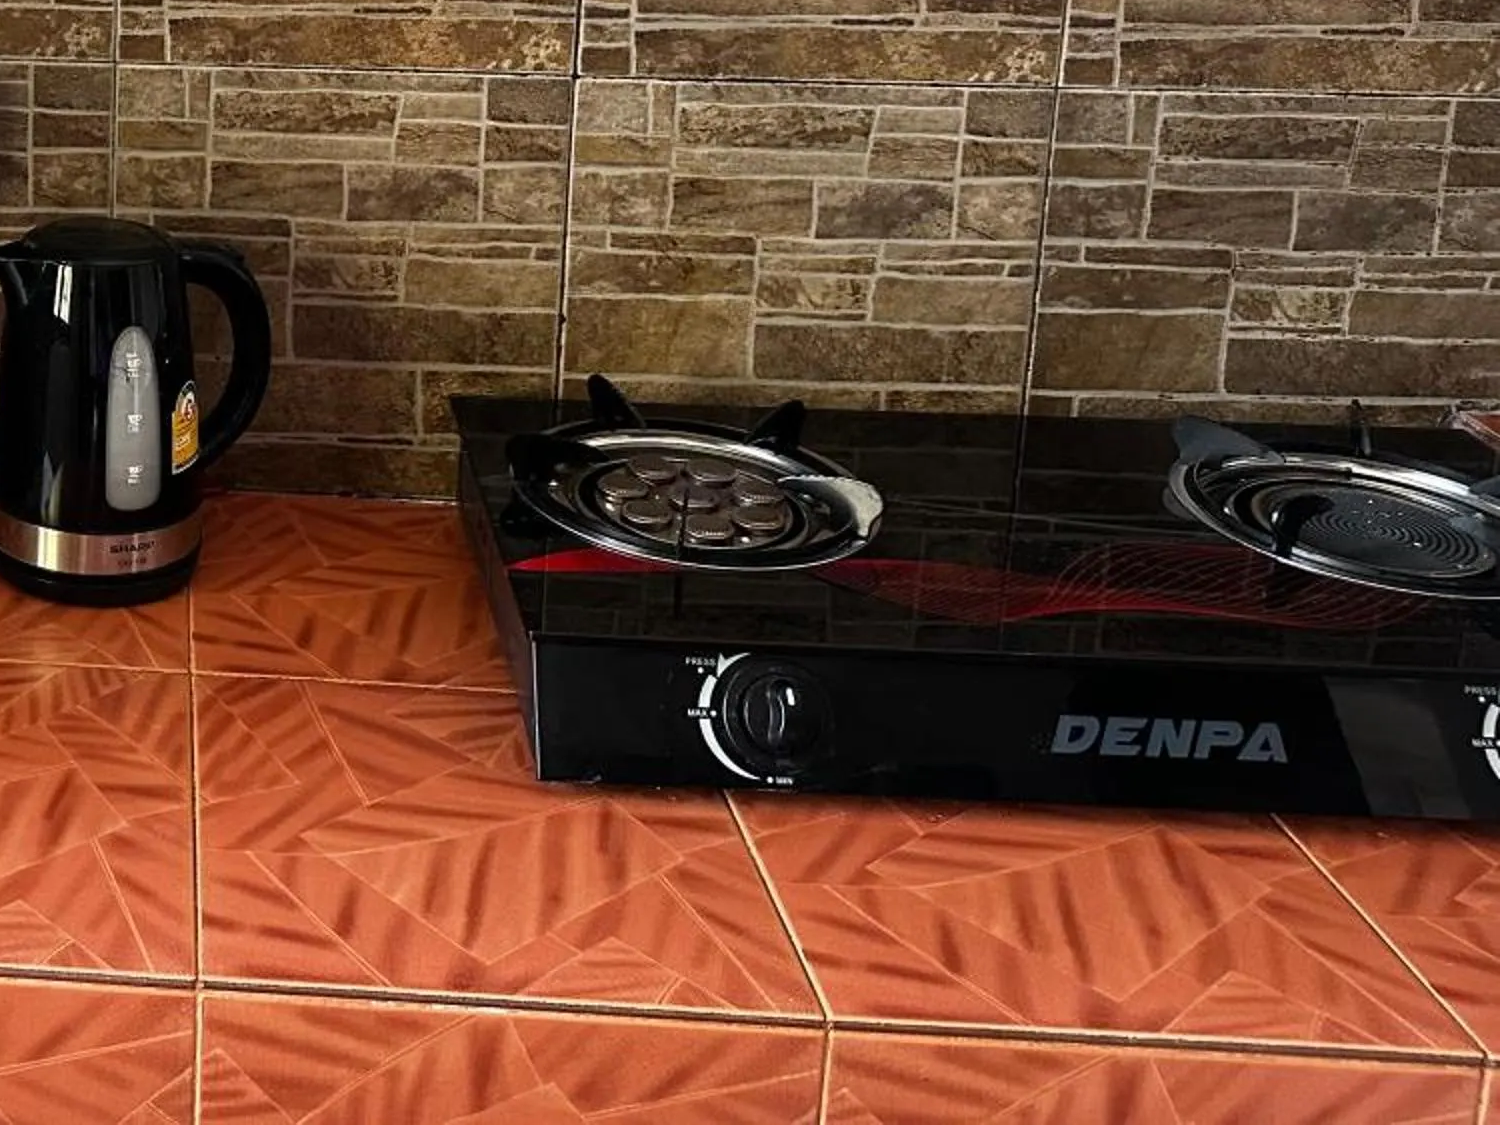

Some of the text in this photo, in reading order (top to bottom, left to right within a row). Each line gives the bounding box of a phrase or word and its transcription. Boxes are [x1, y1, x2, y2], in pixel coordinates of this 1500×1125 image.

[685, 656, 717, 667] PRESS
[687, 708, 708, 717] MAX
[1051, 715, 1289, 763] DENPA
[775, 776, 794, 785] MIN
